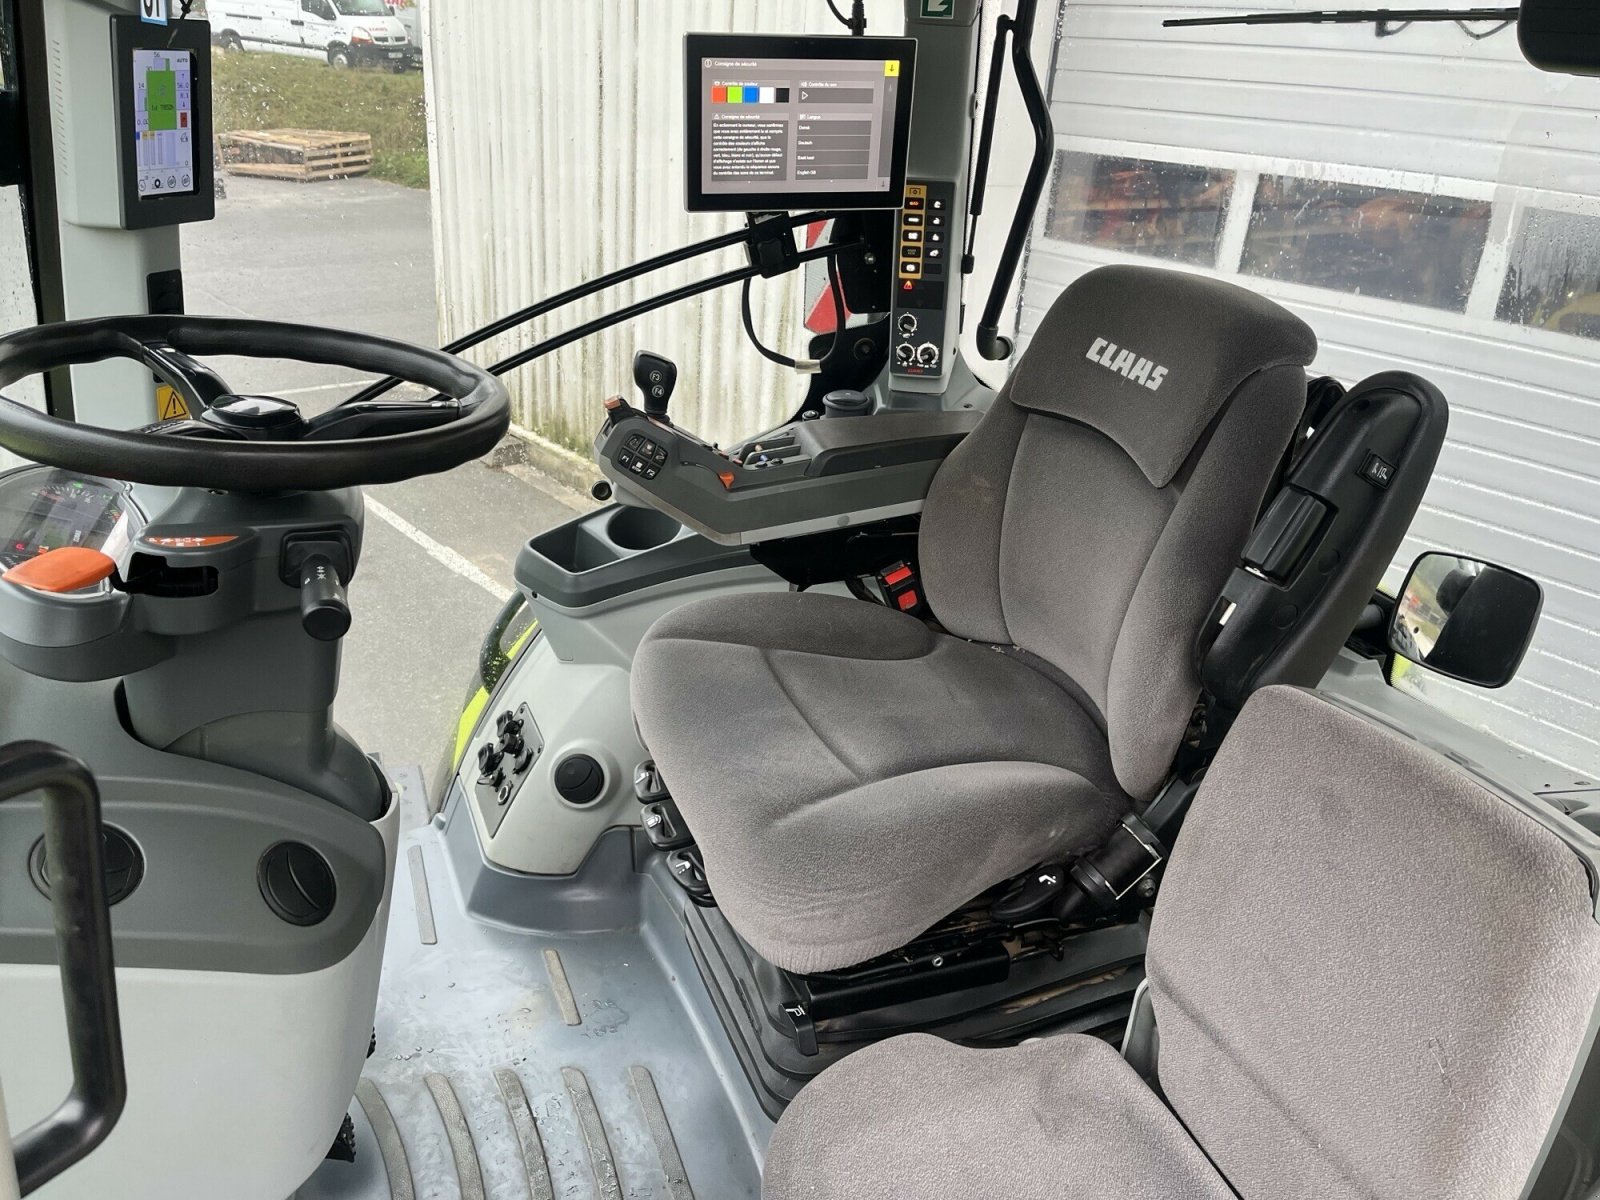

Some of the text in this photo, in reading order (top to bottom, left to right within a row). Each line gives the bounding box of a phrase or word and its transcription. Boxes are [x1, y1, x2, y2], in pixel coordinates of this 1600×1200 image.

[1086, 337, 1168, 391] CLAAS
[654, 388, 662, 396] F4
[646, 468, 656, 476] F2
